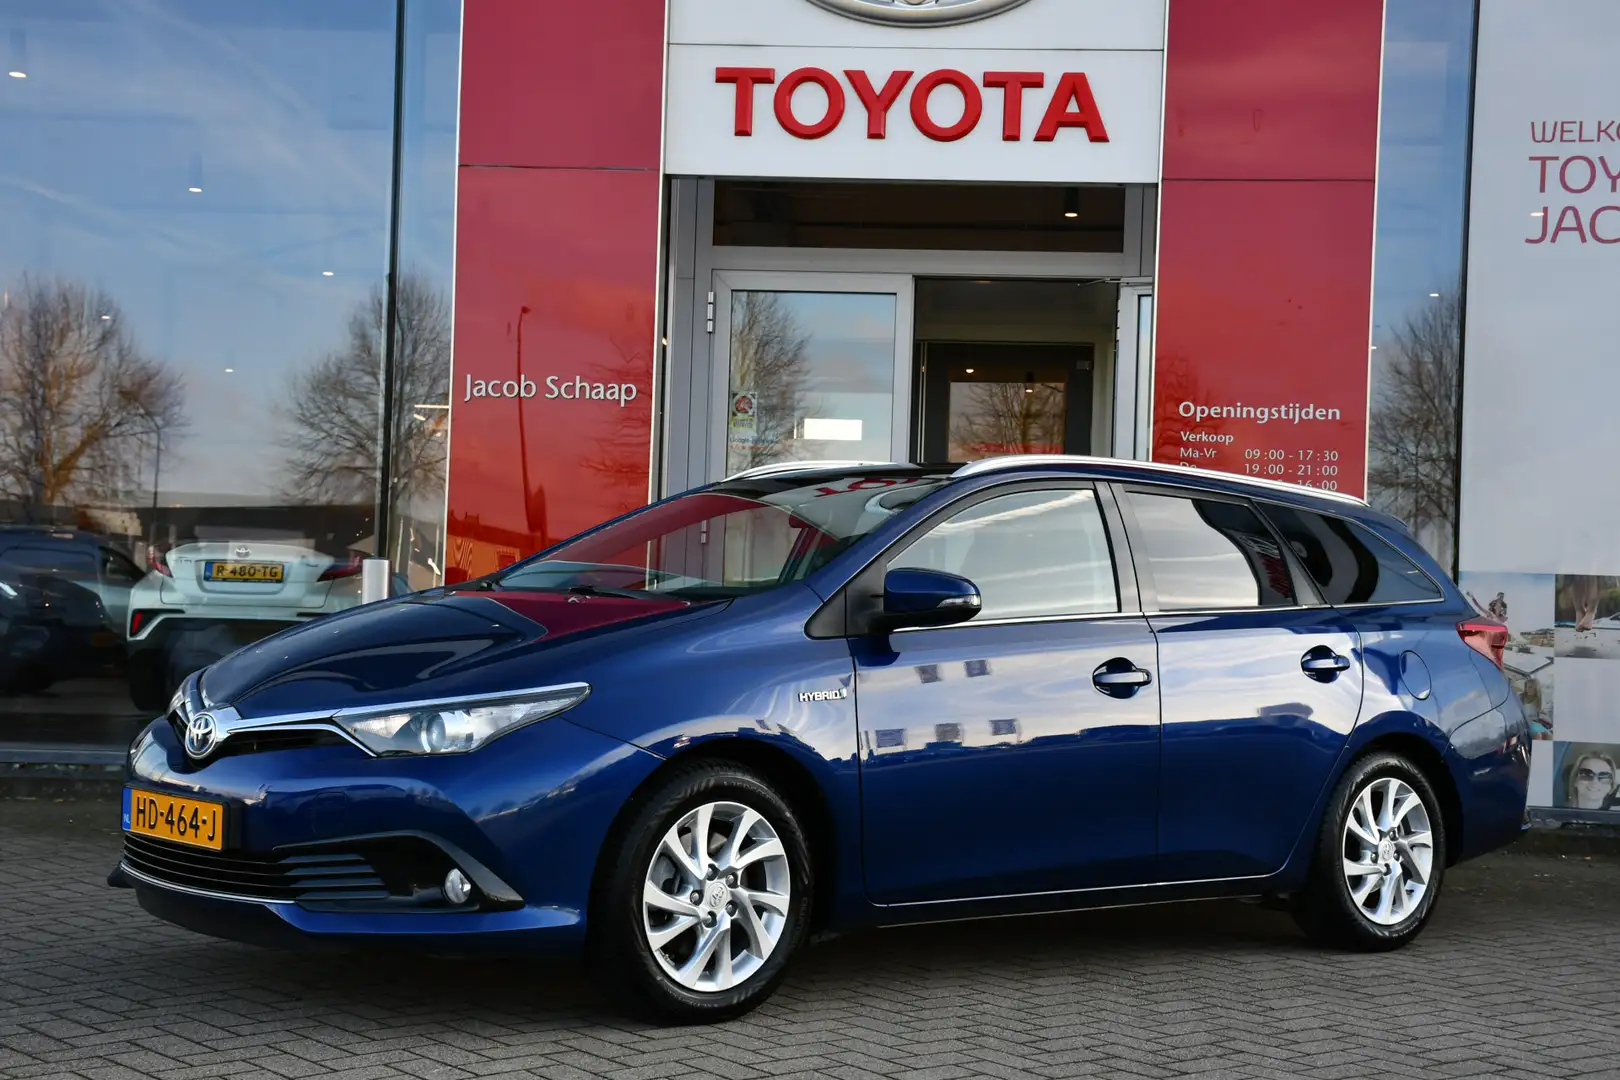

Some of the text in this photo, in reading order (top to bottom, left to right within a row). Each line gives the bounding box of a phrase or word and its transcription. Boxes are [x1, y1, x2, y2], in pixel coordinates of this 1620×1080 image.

[715, 66, 1110, 142] TOYOTA
[1531, 120, 1620, 143] WELK
[464, 374, 637, 407] Jacob Schaap
[1178, 401, 1341, 424] Openingstijden
[1180, 431, 1234, 445] Verkoop
[1179, 447, 1217, 459] Ma-Vr
[216, 564, 278, 577] R-480-TG
[798, 689, 842, 702] HYBRID
[123, 813, 131, 824] NL
[135, 794, 217, 841] HD-464-J
